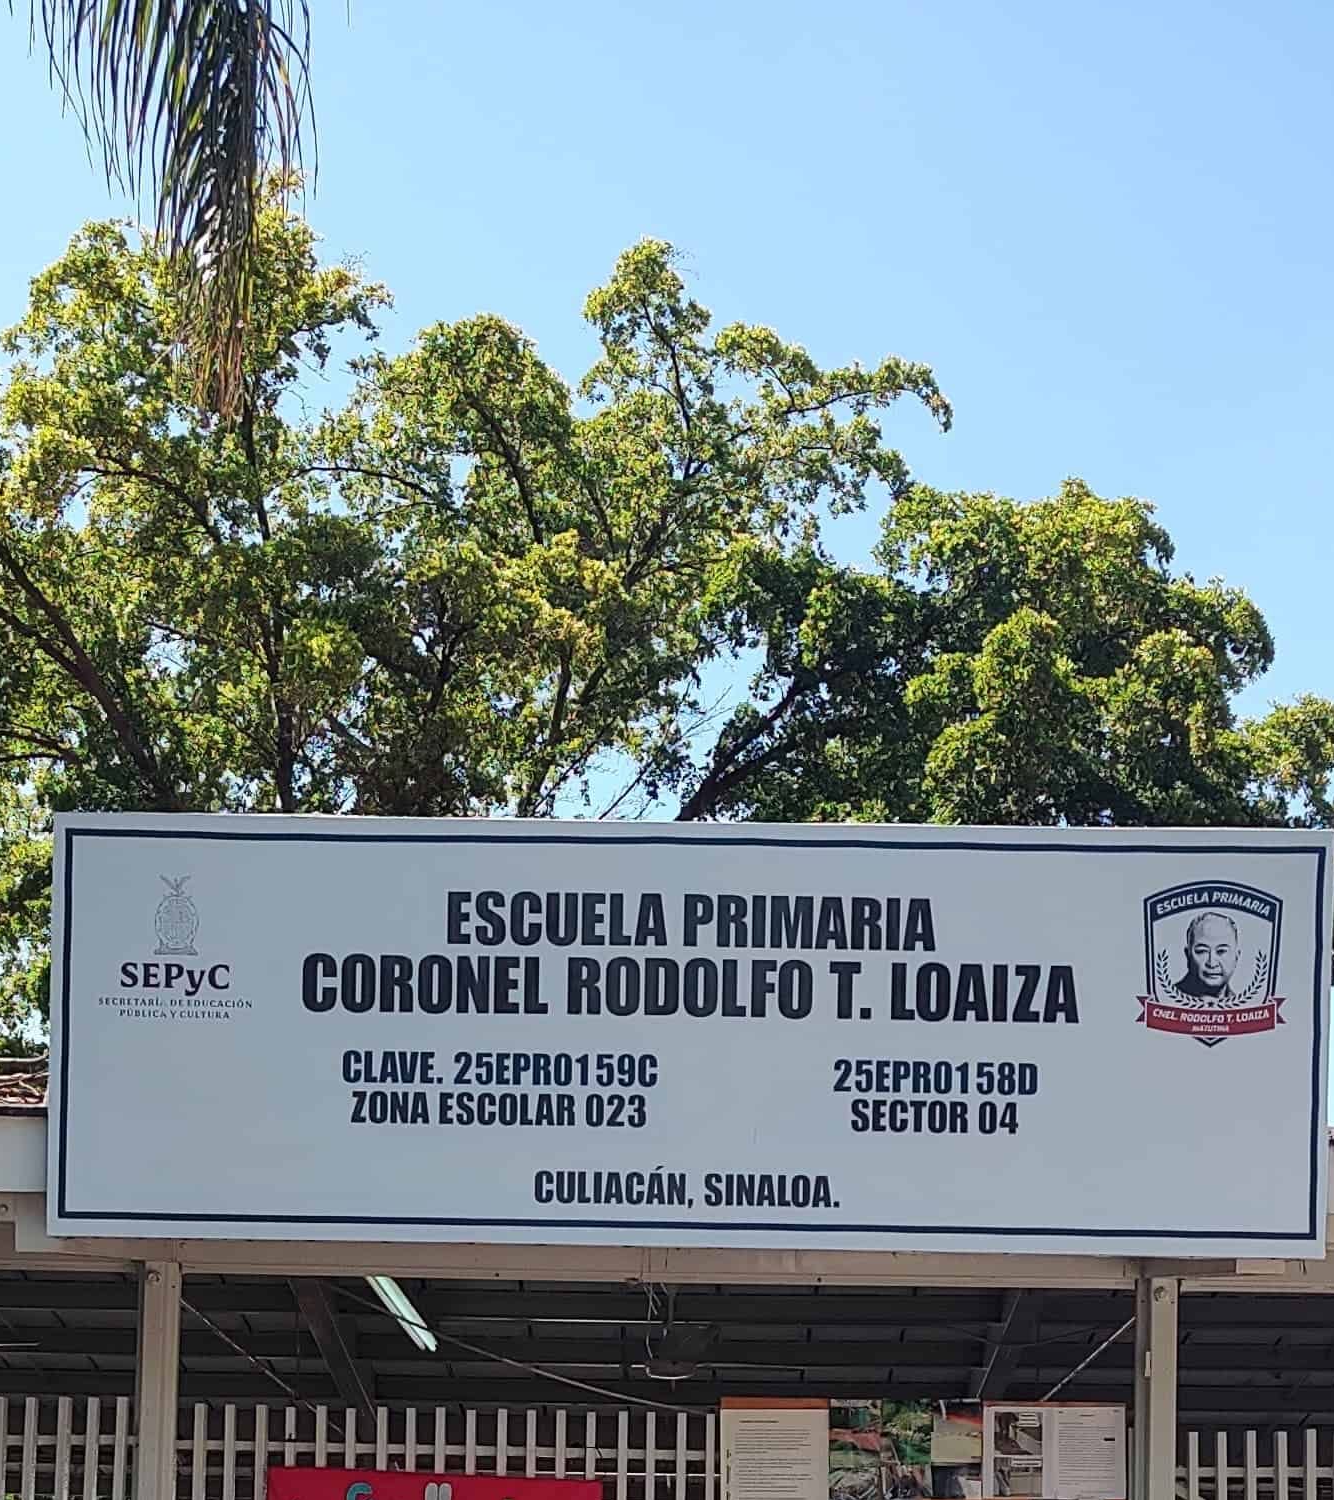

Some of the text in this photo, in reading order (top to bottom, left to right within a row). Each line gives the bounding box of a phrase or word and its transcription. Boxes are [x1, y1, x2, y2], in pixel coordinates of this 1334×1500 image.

[445, 890, 938, 953] ESCUELA PRIMARIA
[1156, 891, 1271, 917] ESCUELA PRIMARIA
[119, 961, 231, 997] SEPyC
[301, 952, 1081, 1025] CORONEL RODOLFO T. LOAIZA
[97, 996, 167, 1007] SECRETARÍ
[179, 1010, 230, 1020] CULTURA
[1179, 1013, 1225, 1024] RODOLFO
[1235, 1009, 1270, 1022] LOAIZA
[341, 1049, 660, 1089] CLAVE. 25EPR0159C
[832, 1058, 1040, 1097] 25EPR0158D
[349, 1090, 648, 1130] ZONA ESCOLAR 023
[849, 1098, 1020, 1136] SECTOR 04
[533, 1165, 841, 1210] CULIACÁN, SINALOA.
